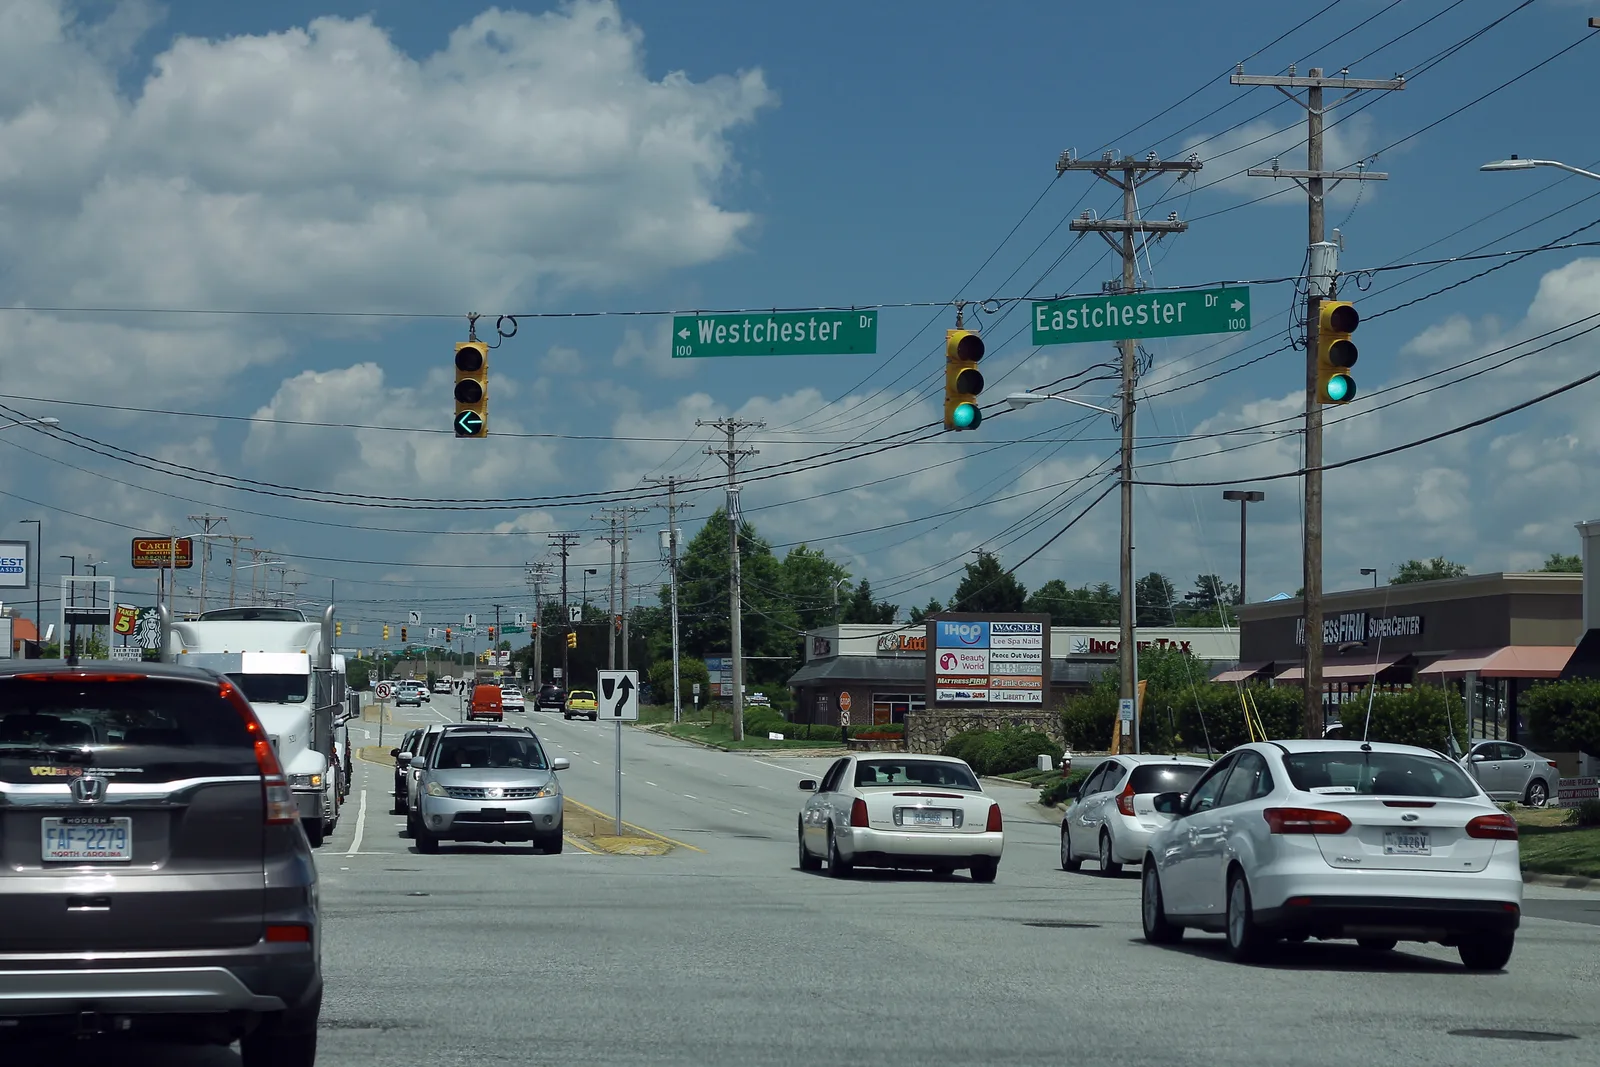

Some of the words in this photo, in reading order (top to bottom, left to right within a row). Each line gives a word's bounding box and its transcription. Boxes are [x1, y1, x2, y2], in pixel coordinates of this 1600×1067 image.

[1036, 301, 1187, 331] Eastchester
[1205, 294, 1218, 307] Dr
[697, 317, 843, 344] Westchester
[859, 315, 873, 328] Dr
[1228, 318, 1246, 330] 100
[676, 345, 692, 356] 100
[0, 557, 24, 566] EST
[117, 607, 134, 616] TAKE
[115, 616, 130, 632] 5
[994, 624, 1039, 632] WAGNER
[1007, 638, 1021, 646] Spa
[1558, 790, 1574, 798] NOW
[1575, 788, 1598, 797] HIRING
[46, 828, 126, 850] FAF-2279
